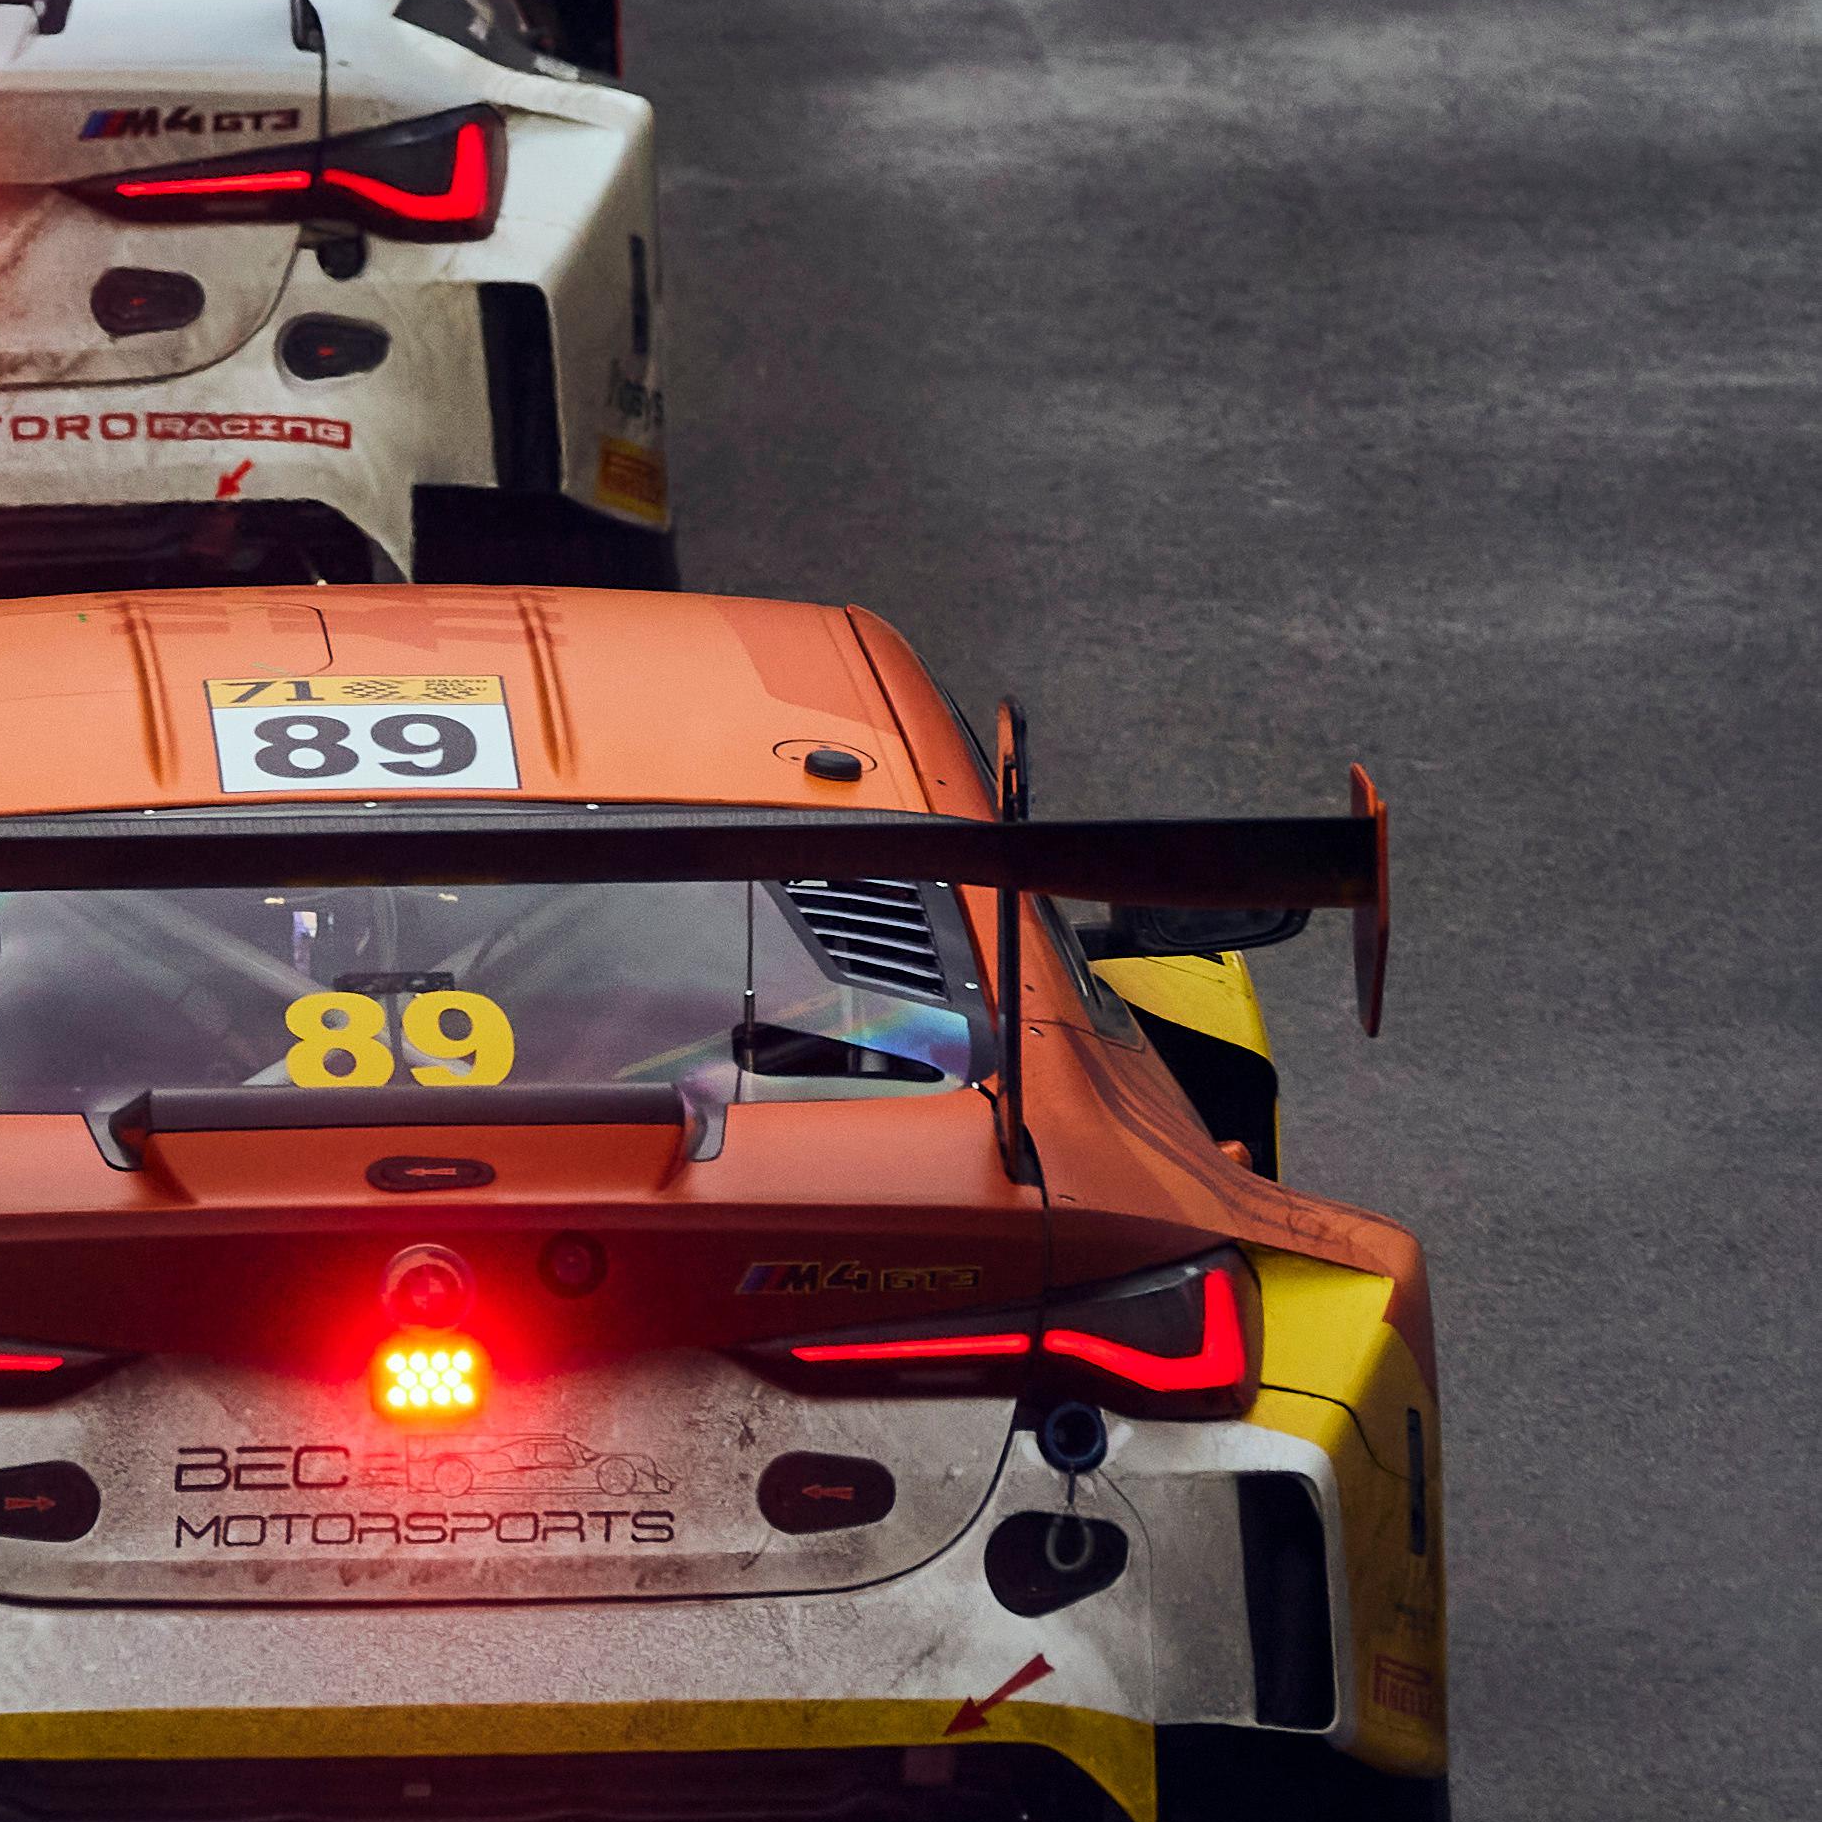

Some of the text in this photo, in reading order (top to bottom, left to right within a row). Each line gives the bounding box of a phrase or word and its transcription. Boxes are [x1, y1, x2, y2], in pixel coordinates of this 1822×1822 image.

[121, 106, 300, 139] M4 GT3
[149, 414, 349, 447] RACING
[221, 680, 326, 704] 71
[254, 713, 478, 778] 89
[285, 990, 515, 1088] 89
[778, 1260, 982, 1294] M4 GT3
[174, 1445, 350, 1493] BEC
[174, 1509, 676, 1548] MOTORSPORTS
